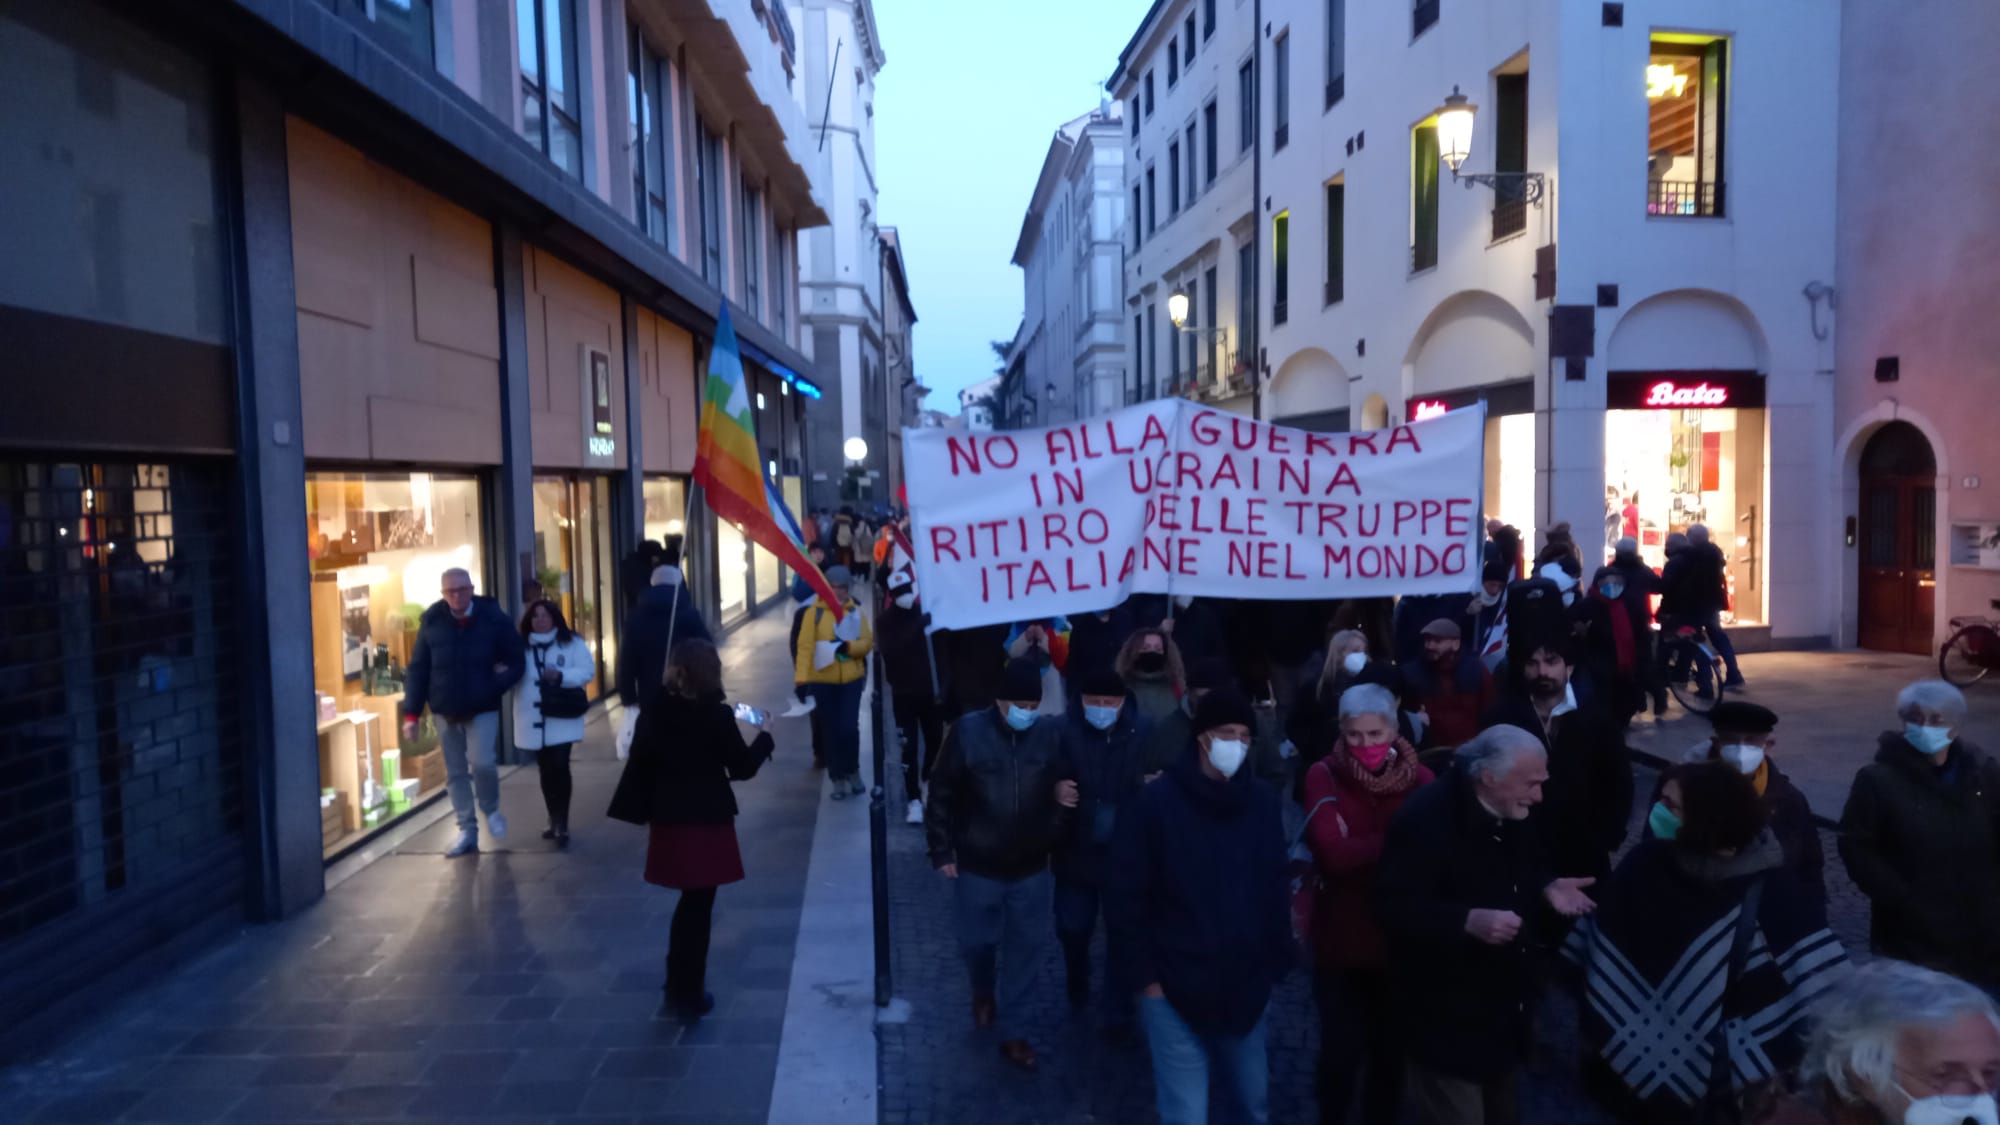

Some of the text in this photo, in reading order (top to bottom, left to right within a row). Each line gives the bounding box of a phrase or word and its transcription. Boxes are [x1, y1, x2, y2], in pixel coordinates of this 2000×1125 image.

[1647, 382, 1728, 406] Bata
[947, 435, 1018, 476] NO
[1045, 414, 1168, 466] ALLA
[1030, 450, 1361, 508] IN UCRAINA
[930, 494, 1472, 564] RITIRO DELLE TRUPPE
[981, 535, 1466, 603] ITALIANE NEL MONDO
